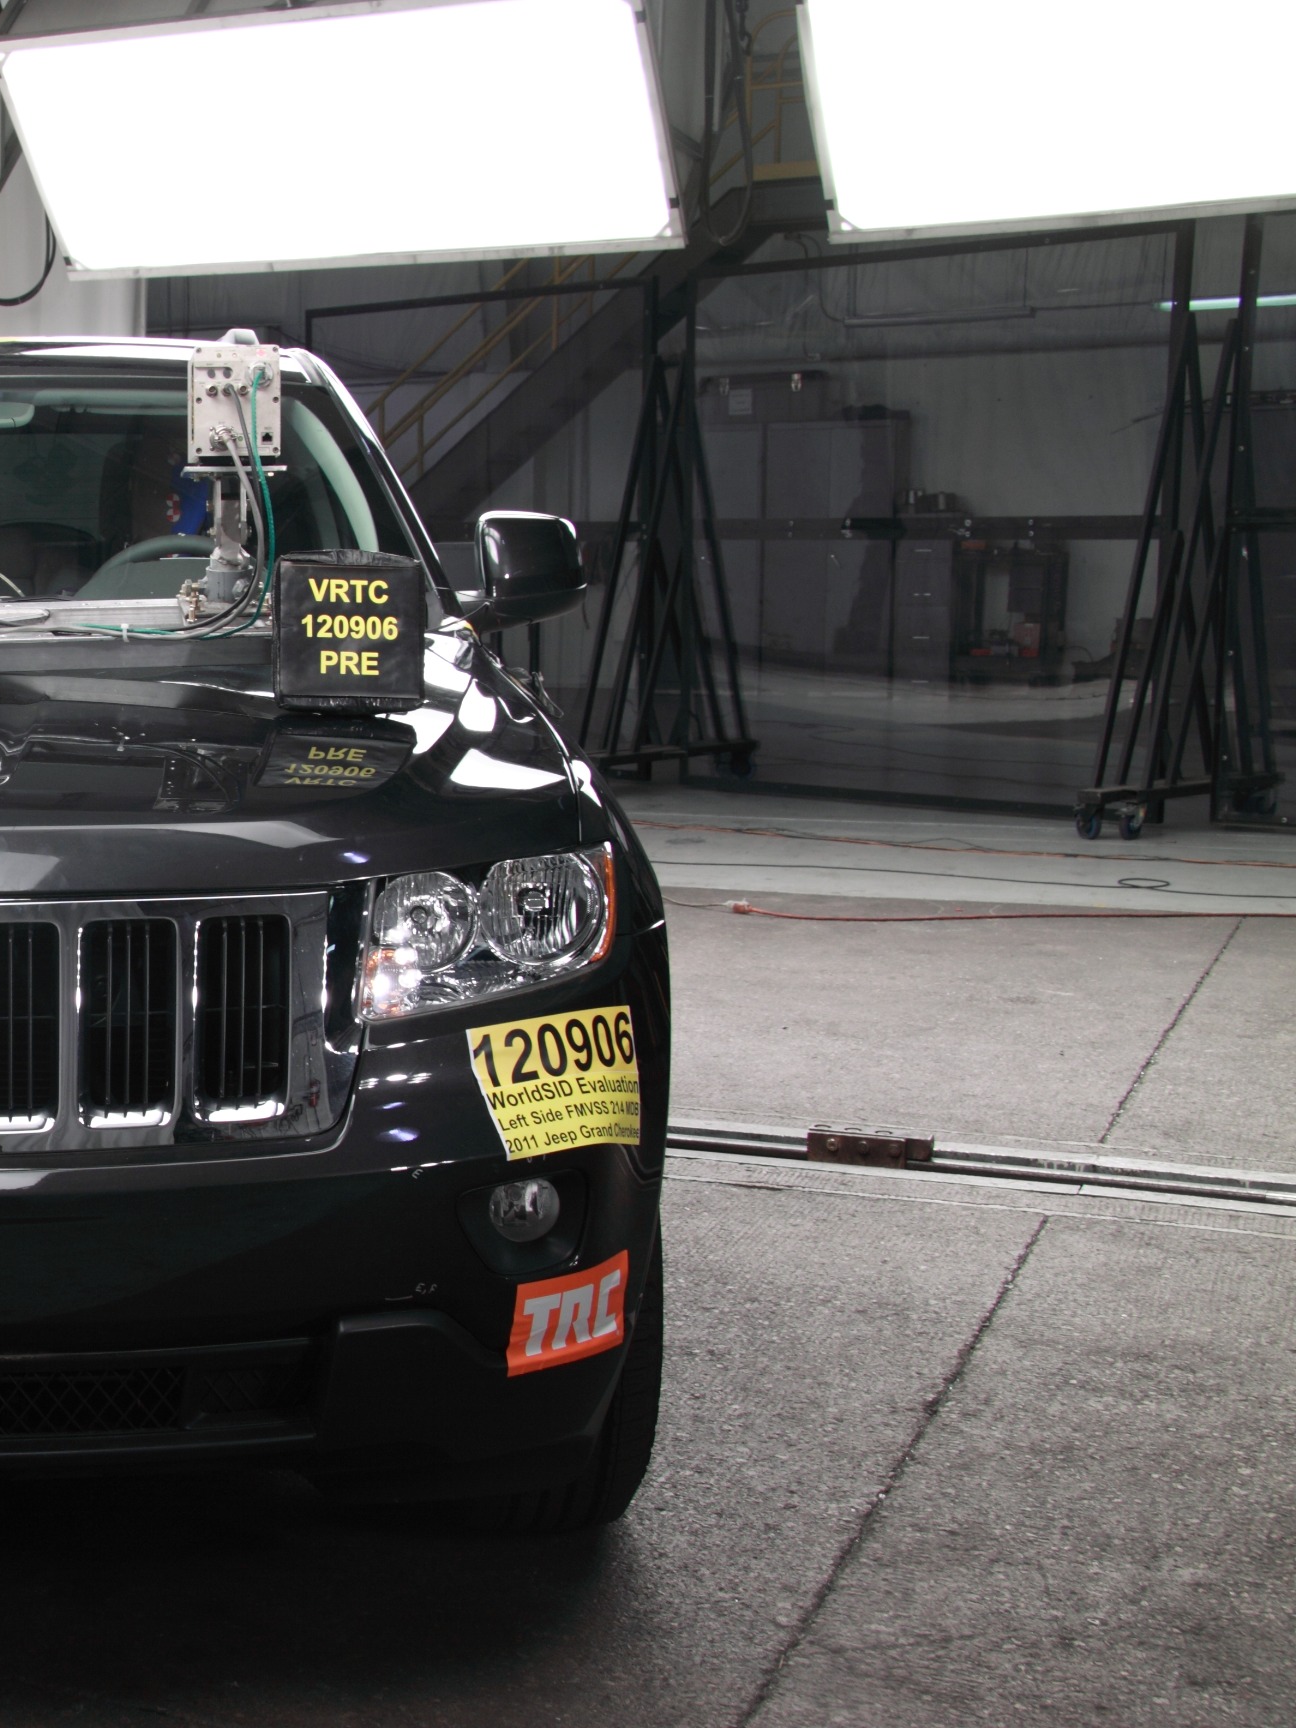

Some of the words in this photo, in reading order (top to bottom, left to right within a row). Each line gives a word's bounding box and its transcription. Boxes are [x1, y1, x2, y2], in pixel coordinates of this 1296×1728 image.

[308, 578, 389, 604] VRTC
[301, 614, 398, 640] 120906
[319, 650, 380, 675] PRE
[473, 1011, 634, 1088] 120906
[486, 1079, 574, 1111] WorldSID
[575, 1074, 639, 1095] Evaluation
[498, 1113, 529, 1132] Left
[530, 1108, 564, 1125] Side
[565, 1100, 609, 1119] FMVSS
[610, 1100, 624, 1115] 214
[505, 1134, 539, 1154] 2011
[544, 1129, 578, 1147] Jeep
[580, 1122, 613, 1139] Grand
[614, 1122, 640, 1139] Cherokee
[523, 1268, 621, 1357] TRC
